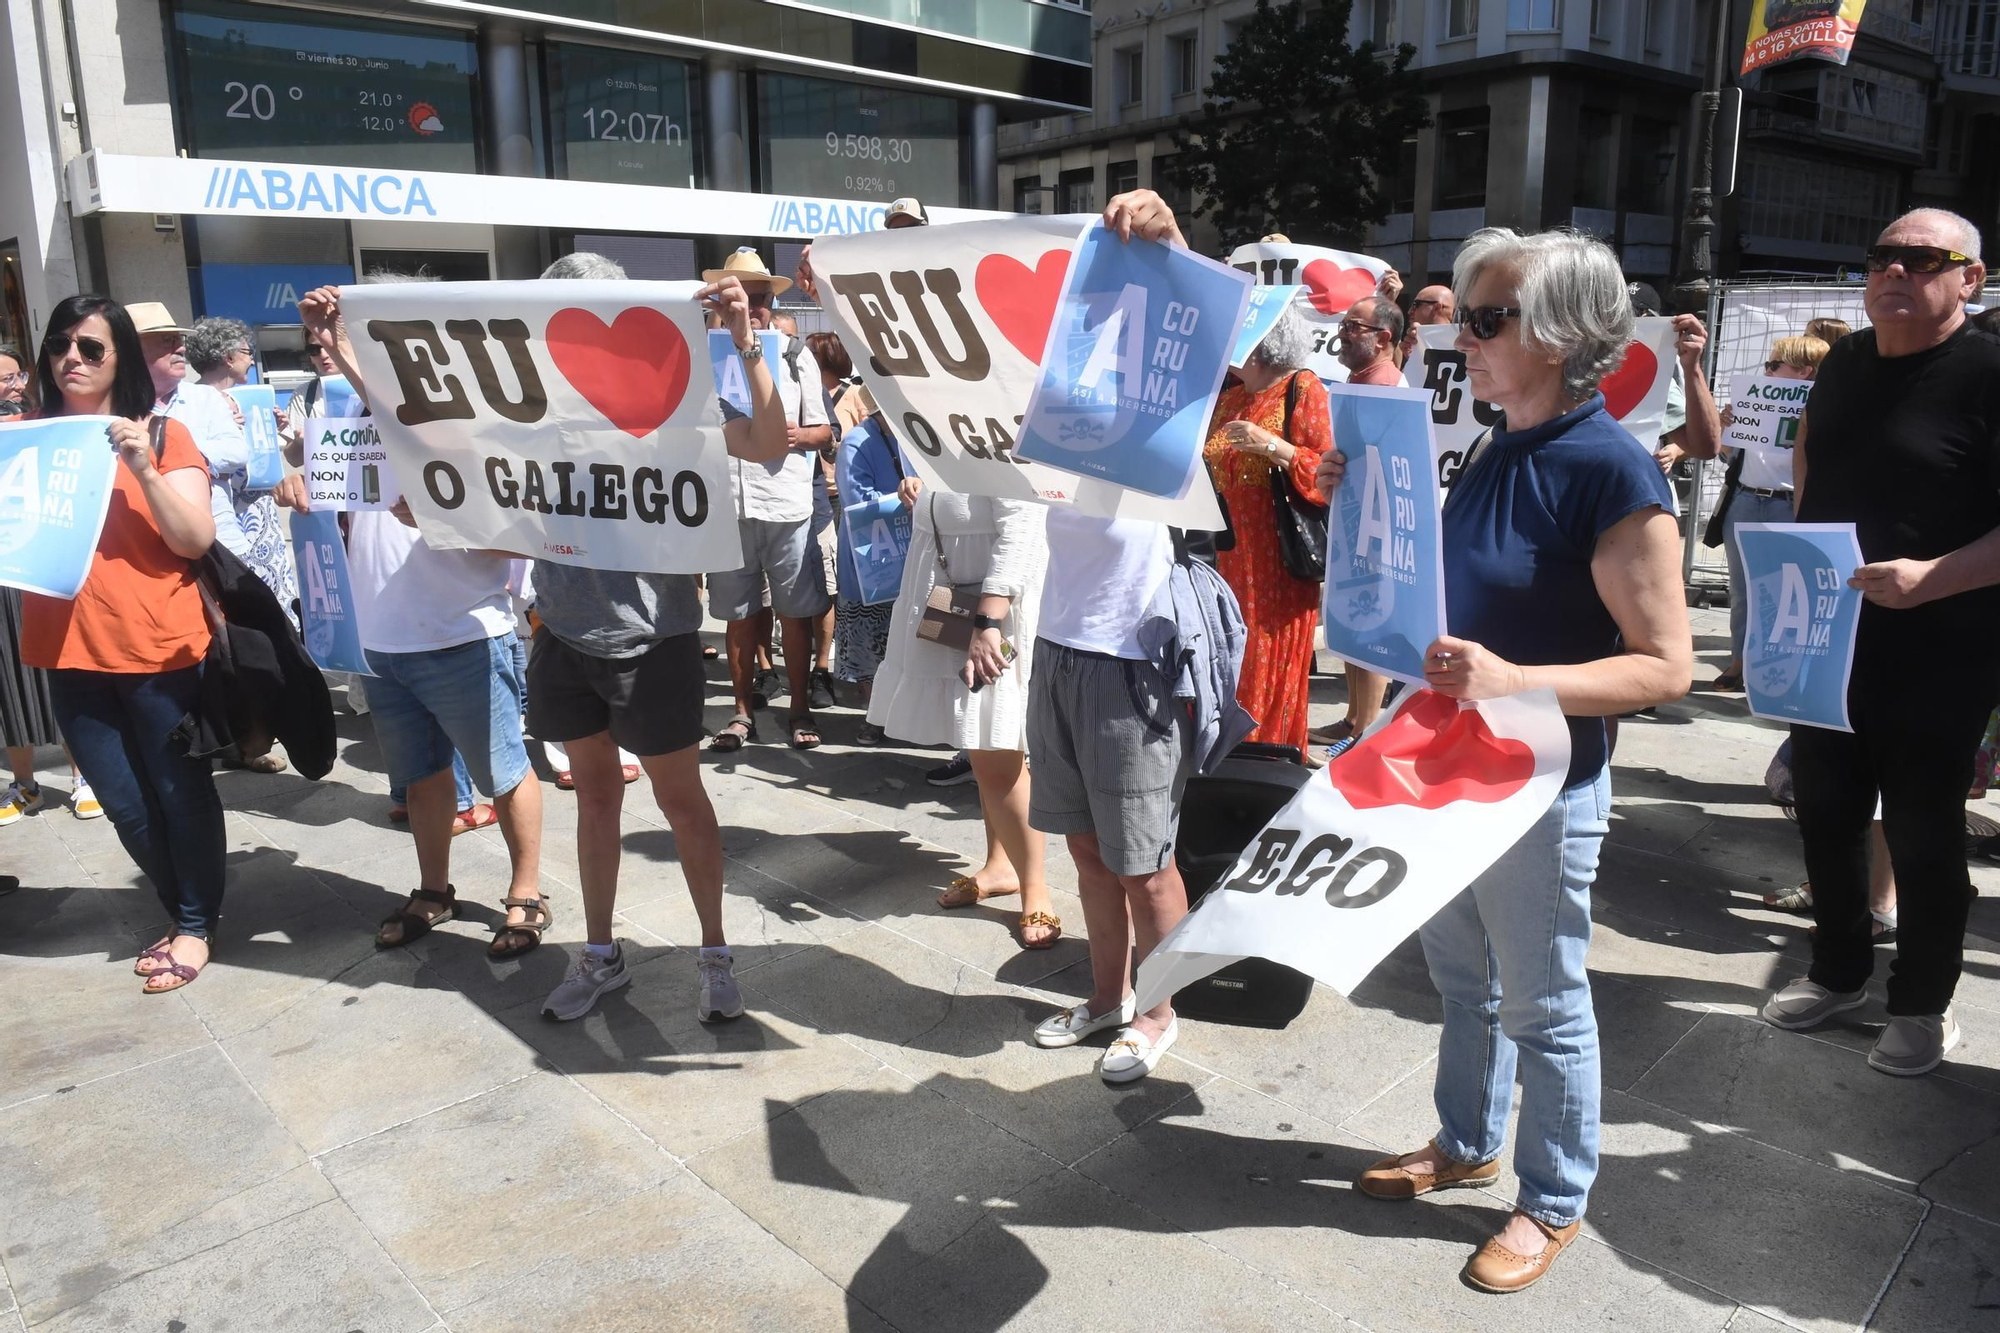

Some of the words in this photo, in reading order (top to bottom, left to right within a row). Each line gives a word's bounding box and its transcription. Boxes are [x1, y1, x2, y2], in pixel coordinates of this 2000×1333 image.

[1745, 53, 1756, 67] 14
[1771, 40, 1785, 54] 16
[1789, 30, 1848, 48] XULLO
[1755, 29, 1791, 49] NOVAS
[1794, 21, 1834, 34] DATAS
[307, 53, 344, 65] viernes
[346, 57, 358, 67] 30
[365, 60, 390, 70] Junio
[583, 107, 682, 147] 12:07h
[825, 131, 913, 166] 9.598,30
[844, 175, 884, 193] 0,92%
[829, 267, 991, 383] EU
[1162, 300, 1200, 337] CO
[1078, 282, 1148, 400] A
[1151, 336, 1190, 372] RU
[367, 318, 548, 426] EU
[720, 354, 751, 403] A
[1144, 368, 1178, 409] ÑA
[1746, 383, 1760, 399] A
[1110, 397, 1177, 420] QUEREMOS!
[1737, 400, 1751, 409] OS
[1752, 402, 1776, 413] QUE
[903, 411, 942, 458] O
[1732, 415, 1761, 427] NON
[320, 429, 337, 447] A
[1731, 431, 1759, 443] USAN
[1760, 436, 1769, 444] O
[52, 448, 82, 471] CO
[310, 452, 328, 462] AS
[331, 452, 357, 464] QUE
[359, 451, 387, 462] SABEN
[46, 470, 79, 495] RU
[310, 471, 345, 482] NON
[1391, 455, 1411, 491] CO
[310, 490, 345, 501] USAN
[348, 492, 358, 501] O
[422, 460, 466, 510] O
[484, 456, 710, 528] GALEGO
[1356, 444, 1392, 566] A
[42, 491, 74, 522] ÑA
[894, 515, 909, 526] CO
[1395, 495, 1416, 532] RU
[871, 518, 900, 562] A
[895, 526, 911, 540] RU
[321, 543, 334, 565] CO
[1392, 531, 1416, 573] ÑA
[305, 540, 331, 614] A
[325, 568, 338, 589] RU
[1815, 567, 1841, 591] CO
[1768, 562, 1810, 646] A
[1814, 595, 1840, 620] RU
[1808, 620, 1831, 648] ÑA
